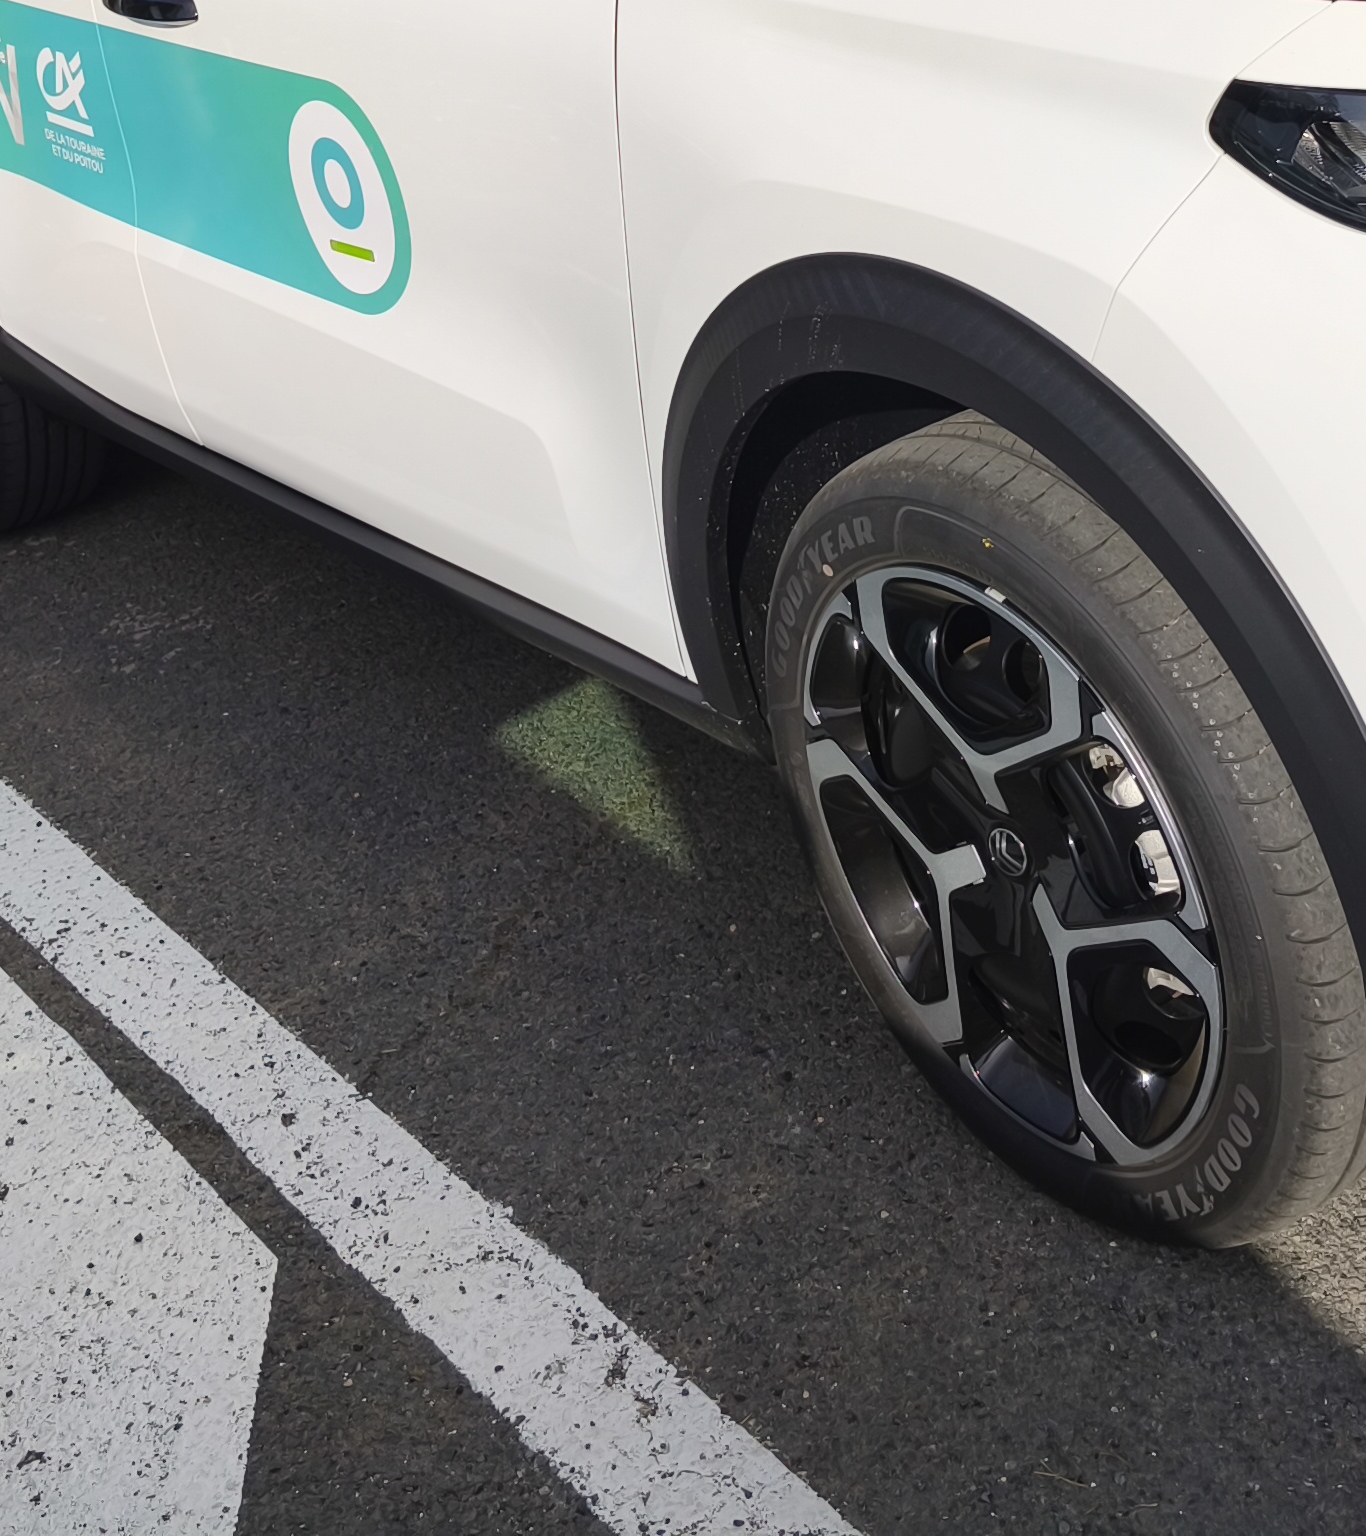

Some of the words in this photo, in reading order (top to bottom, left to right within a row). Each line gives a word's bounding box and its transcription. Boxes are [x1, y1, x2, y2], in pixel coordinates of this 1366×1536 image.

[51, 143, 62, 158] ET
[61, 147, 74, 163] DU
[73, 152, 104, 175] POITOU
